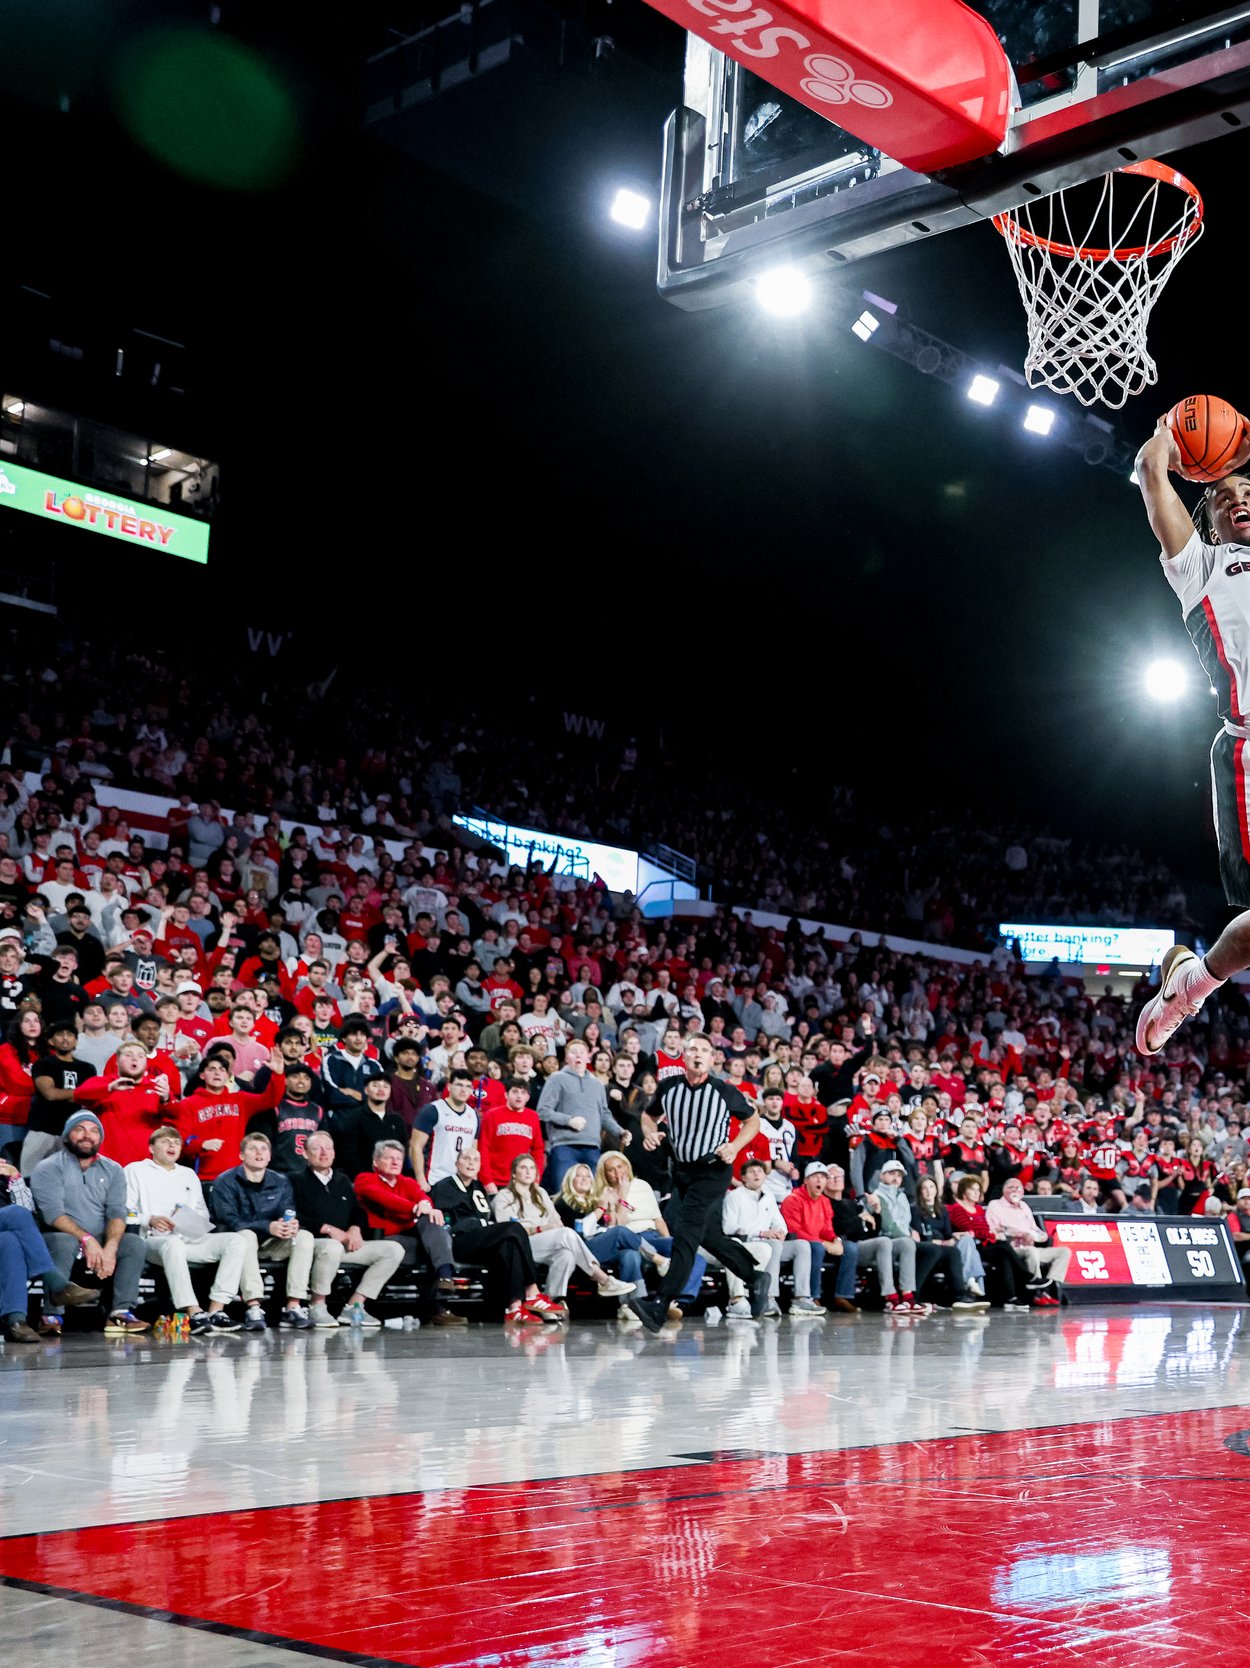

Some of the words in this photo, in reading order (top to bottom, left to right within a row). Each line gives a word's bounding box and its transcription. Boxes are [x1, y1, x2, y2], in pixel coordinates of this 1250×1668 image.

[84, 493, 137, 516] GEORGIA
[472, 1192, 490, 1214] G
[1166, 1228, 1191, 1245] OLE
[1076, 1250, 1109, 1279] 52
[1186, 1250, 1215, 1277] 50
